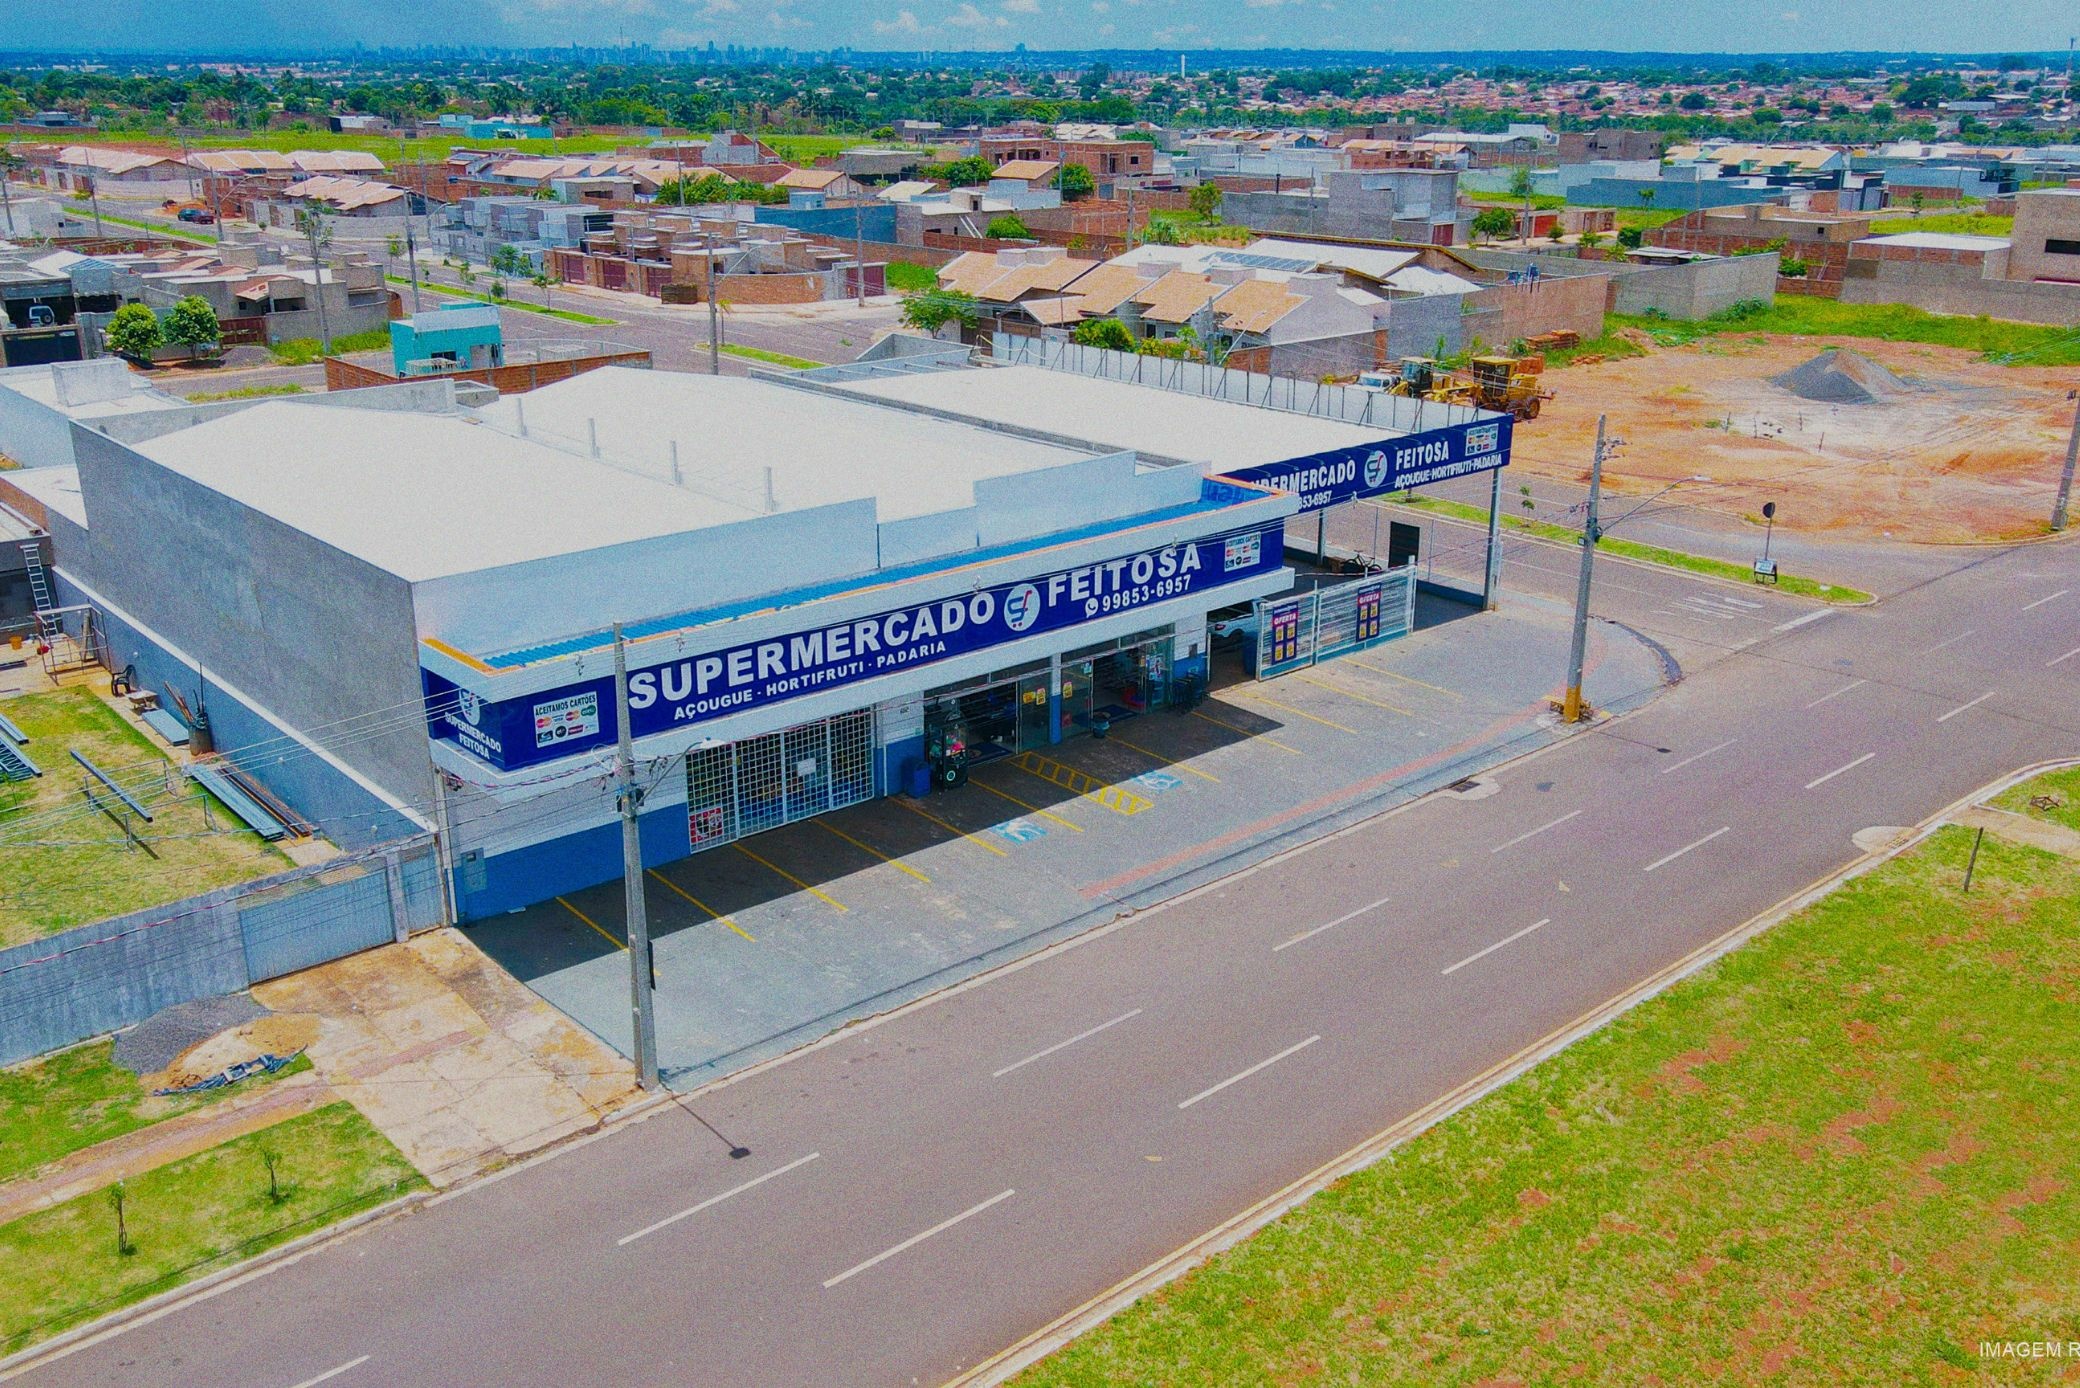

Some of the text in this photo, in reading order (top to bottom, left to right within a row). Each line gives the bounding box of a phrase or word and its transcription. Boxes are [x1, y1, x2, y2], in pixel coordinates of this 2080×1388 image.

[1395, 441, 1449, 471] FEITOSA
[1102, 574, 1191, 612] 99853-6957
[628, 543, 1202, 709] SUPERMERCADO FEITOSA
[674, 689, 753, 720] AÇOUGUE
[766, 661, 863, 697] HORTIFRUTI
[877, 640, 946, 668] PADARIA
[536, 701, 569, 716] ACEITAMOS
[444, 711, 502, 753] SUPERMERCADO
[459, 732, 490, 759] FEITOSA
